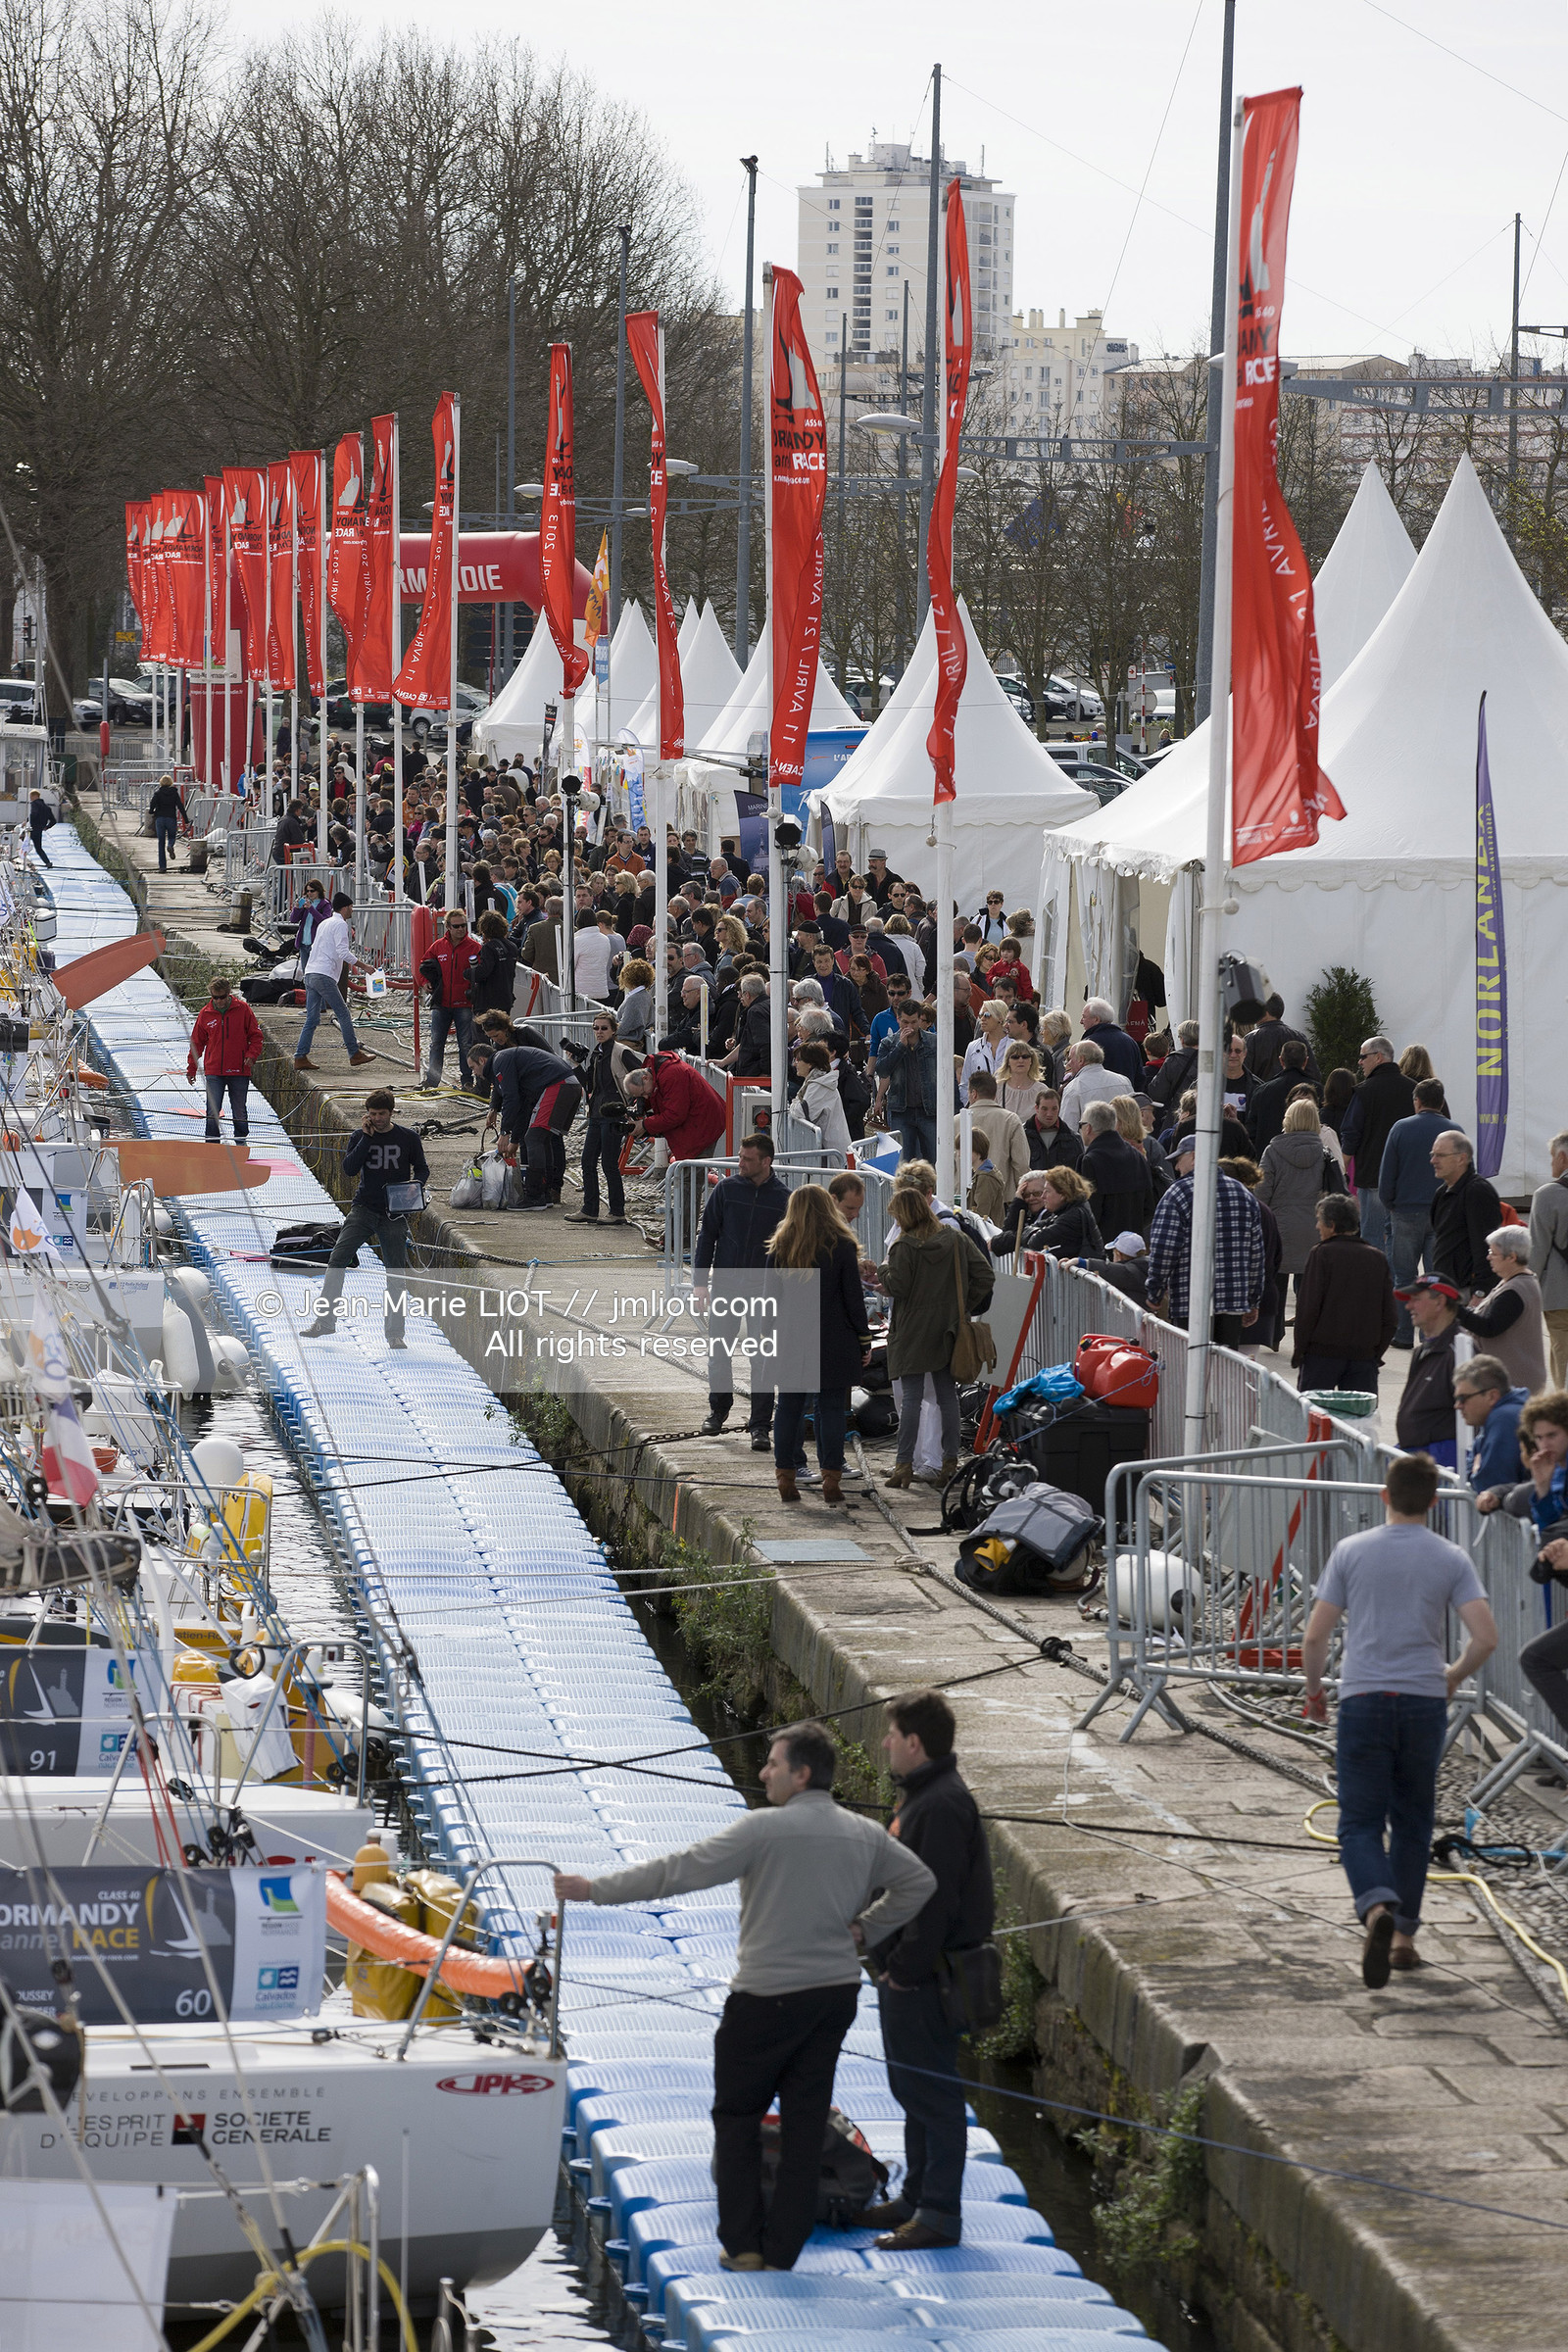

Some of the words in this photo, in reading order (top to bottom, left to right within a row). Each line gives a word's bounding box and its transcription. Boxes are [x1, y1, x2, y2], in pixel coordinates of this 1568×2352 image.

[792, 453, 825, 470] RACE
[366, 1145, 402, 1170] 3R
[29, 1749, 57, 1771] 91
[98, 1890, 127, 1900] CLASS
[128, 1890, 141, 1900] 40
[175, 1988, 211, 2017] 60
[255, 1990, 297, 2003] Calvados
[212, 2128, 331, 2144] GENERALE
